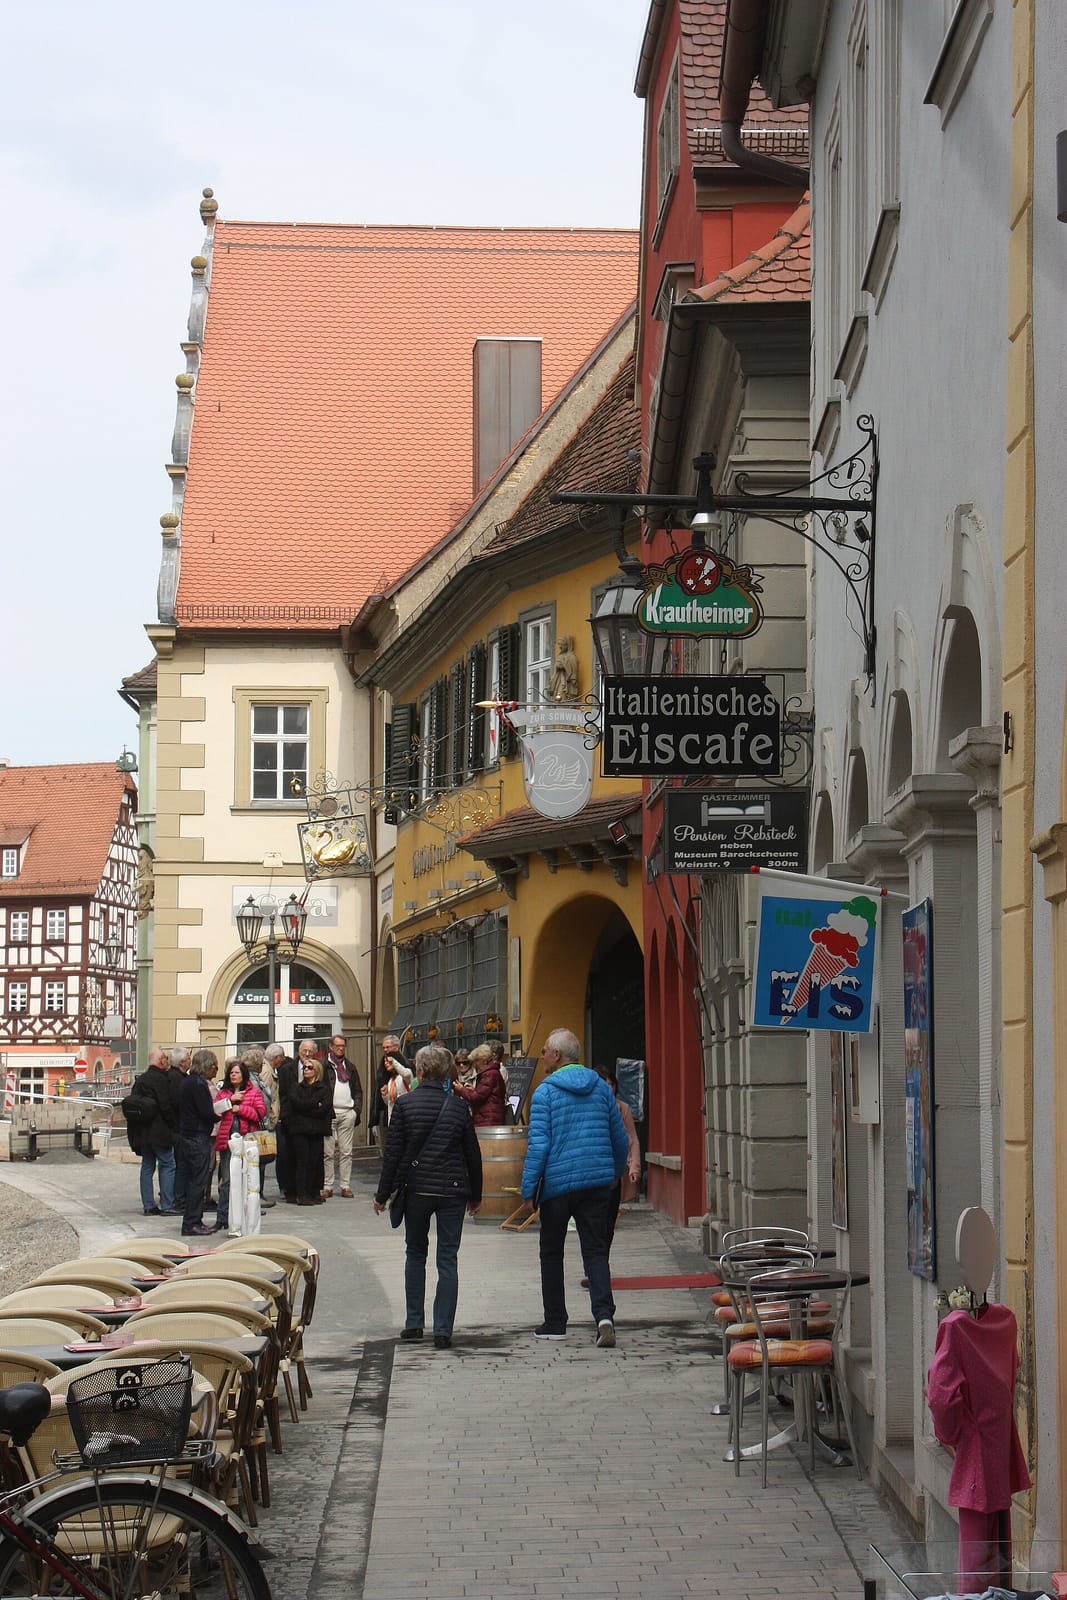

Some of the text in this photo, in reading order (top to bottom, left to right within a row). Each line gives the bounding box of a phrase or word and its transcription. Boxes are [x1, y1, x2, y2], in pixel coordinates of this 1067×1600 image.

[646, 583, 754, 624] Krautheimer
[608, 685, 776, 716] Italienisches
[610, 722, 774, 765] Eiscafe
[673, 824, 797, 841] Pension Rebstock
[775, 907, 818, 926] Ital.
[768, 969, 864, 1021] EIS
